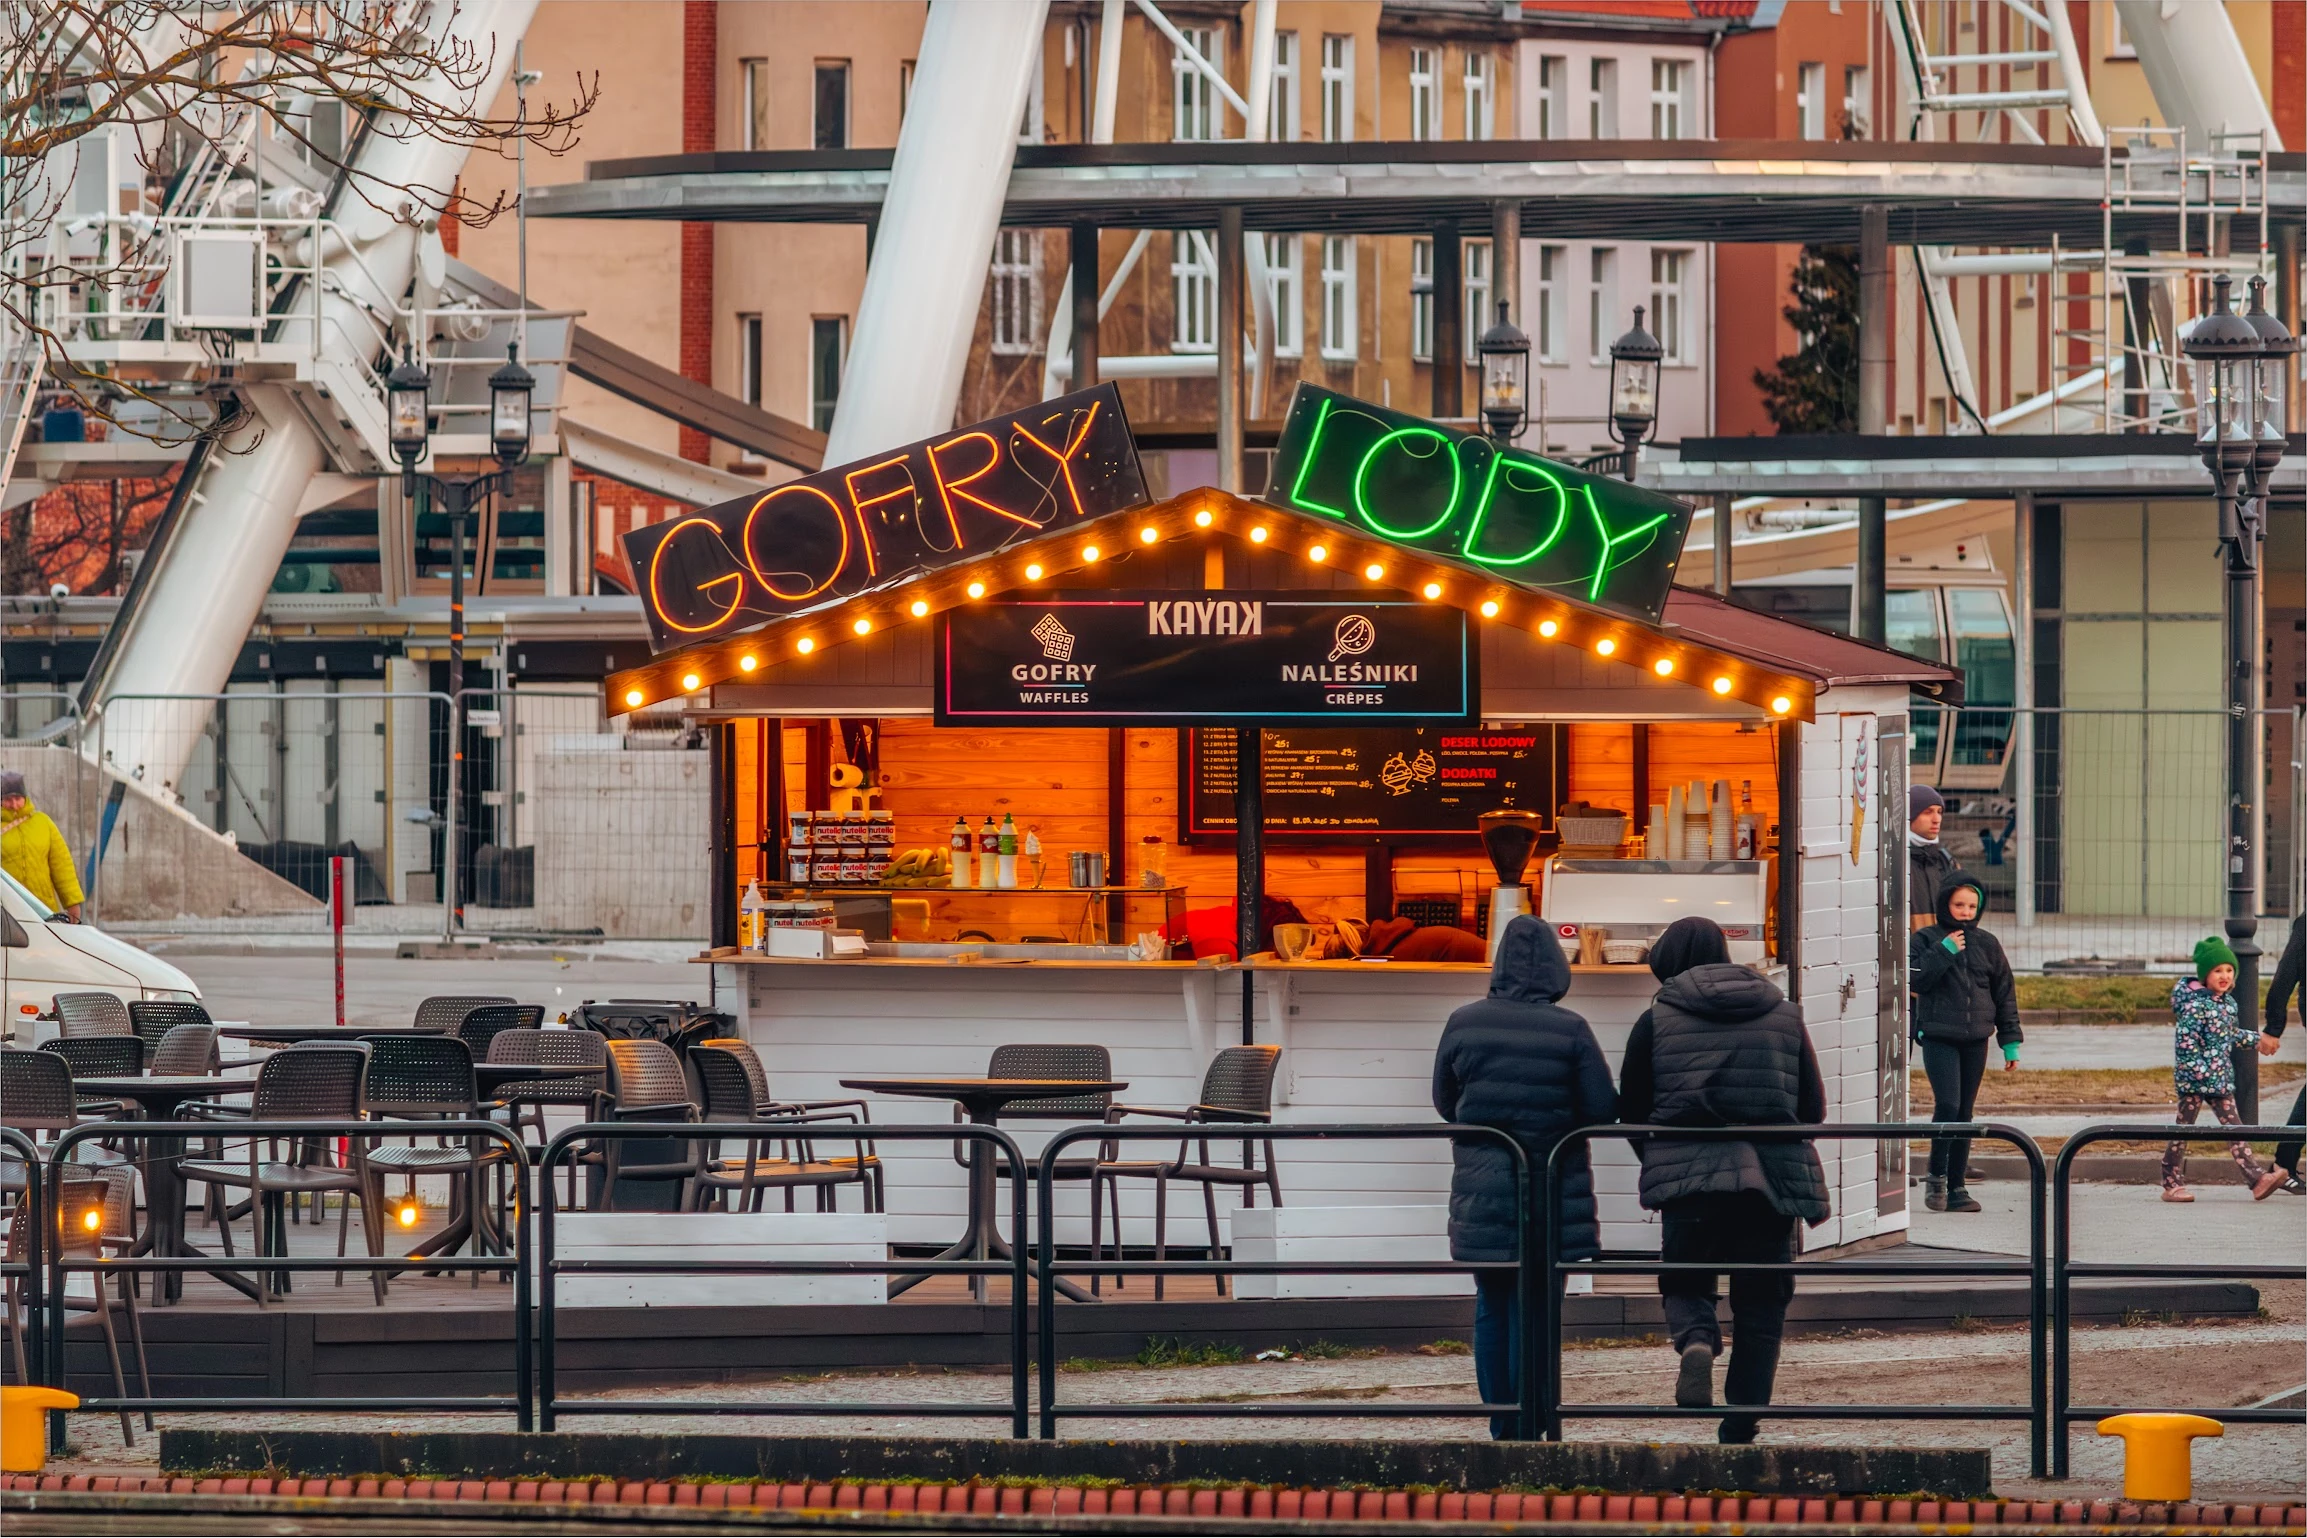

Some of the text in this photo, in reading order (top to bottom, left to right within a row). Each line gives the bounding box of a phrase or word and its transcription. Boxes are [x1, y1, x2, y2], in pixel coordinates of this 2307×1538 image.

[1290, 398, 1668, 602] LODY
[649, 400, 1102, 633] GOFRY
[1149, 601, 1262, 635] KAYAK
[1011, 664, 1097, 681] GOFRY
[1282, 662, 1418, 682] NALEŚNIKI
[1020, 692, 1089, 703] WAFFLES
[1326, 692, 1383, 704] CRÊPES
[1441, 737, 1537, 748] DESER LODOWY
[1441, 768, 1497, 778] DODATKI
[796, 919, 820, 927] nutella
